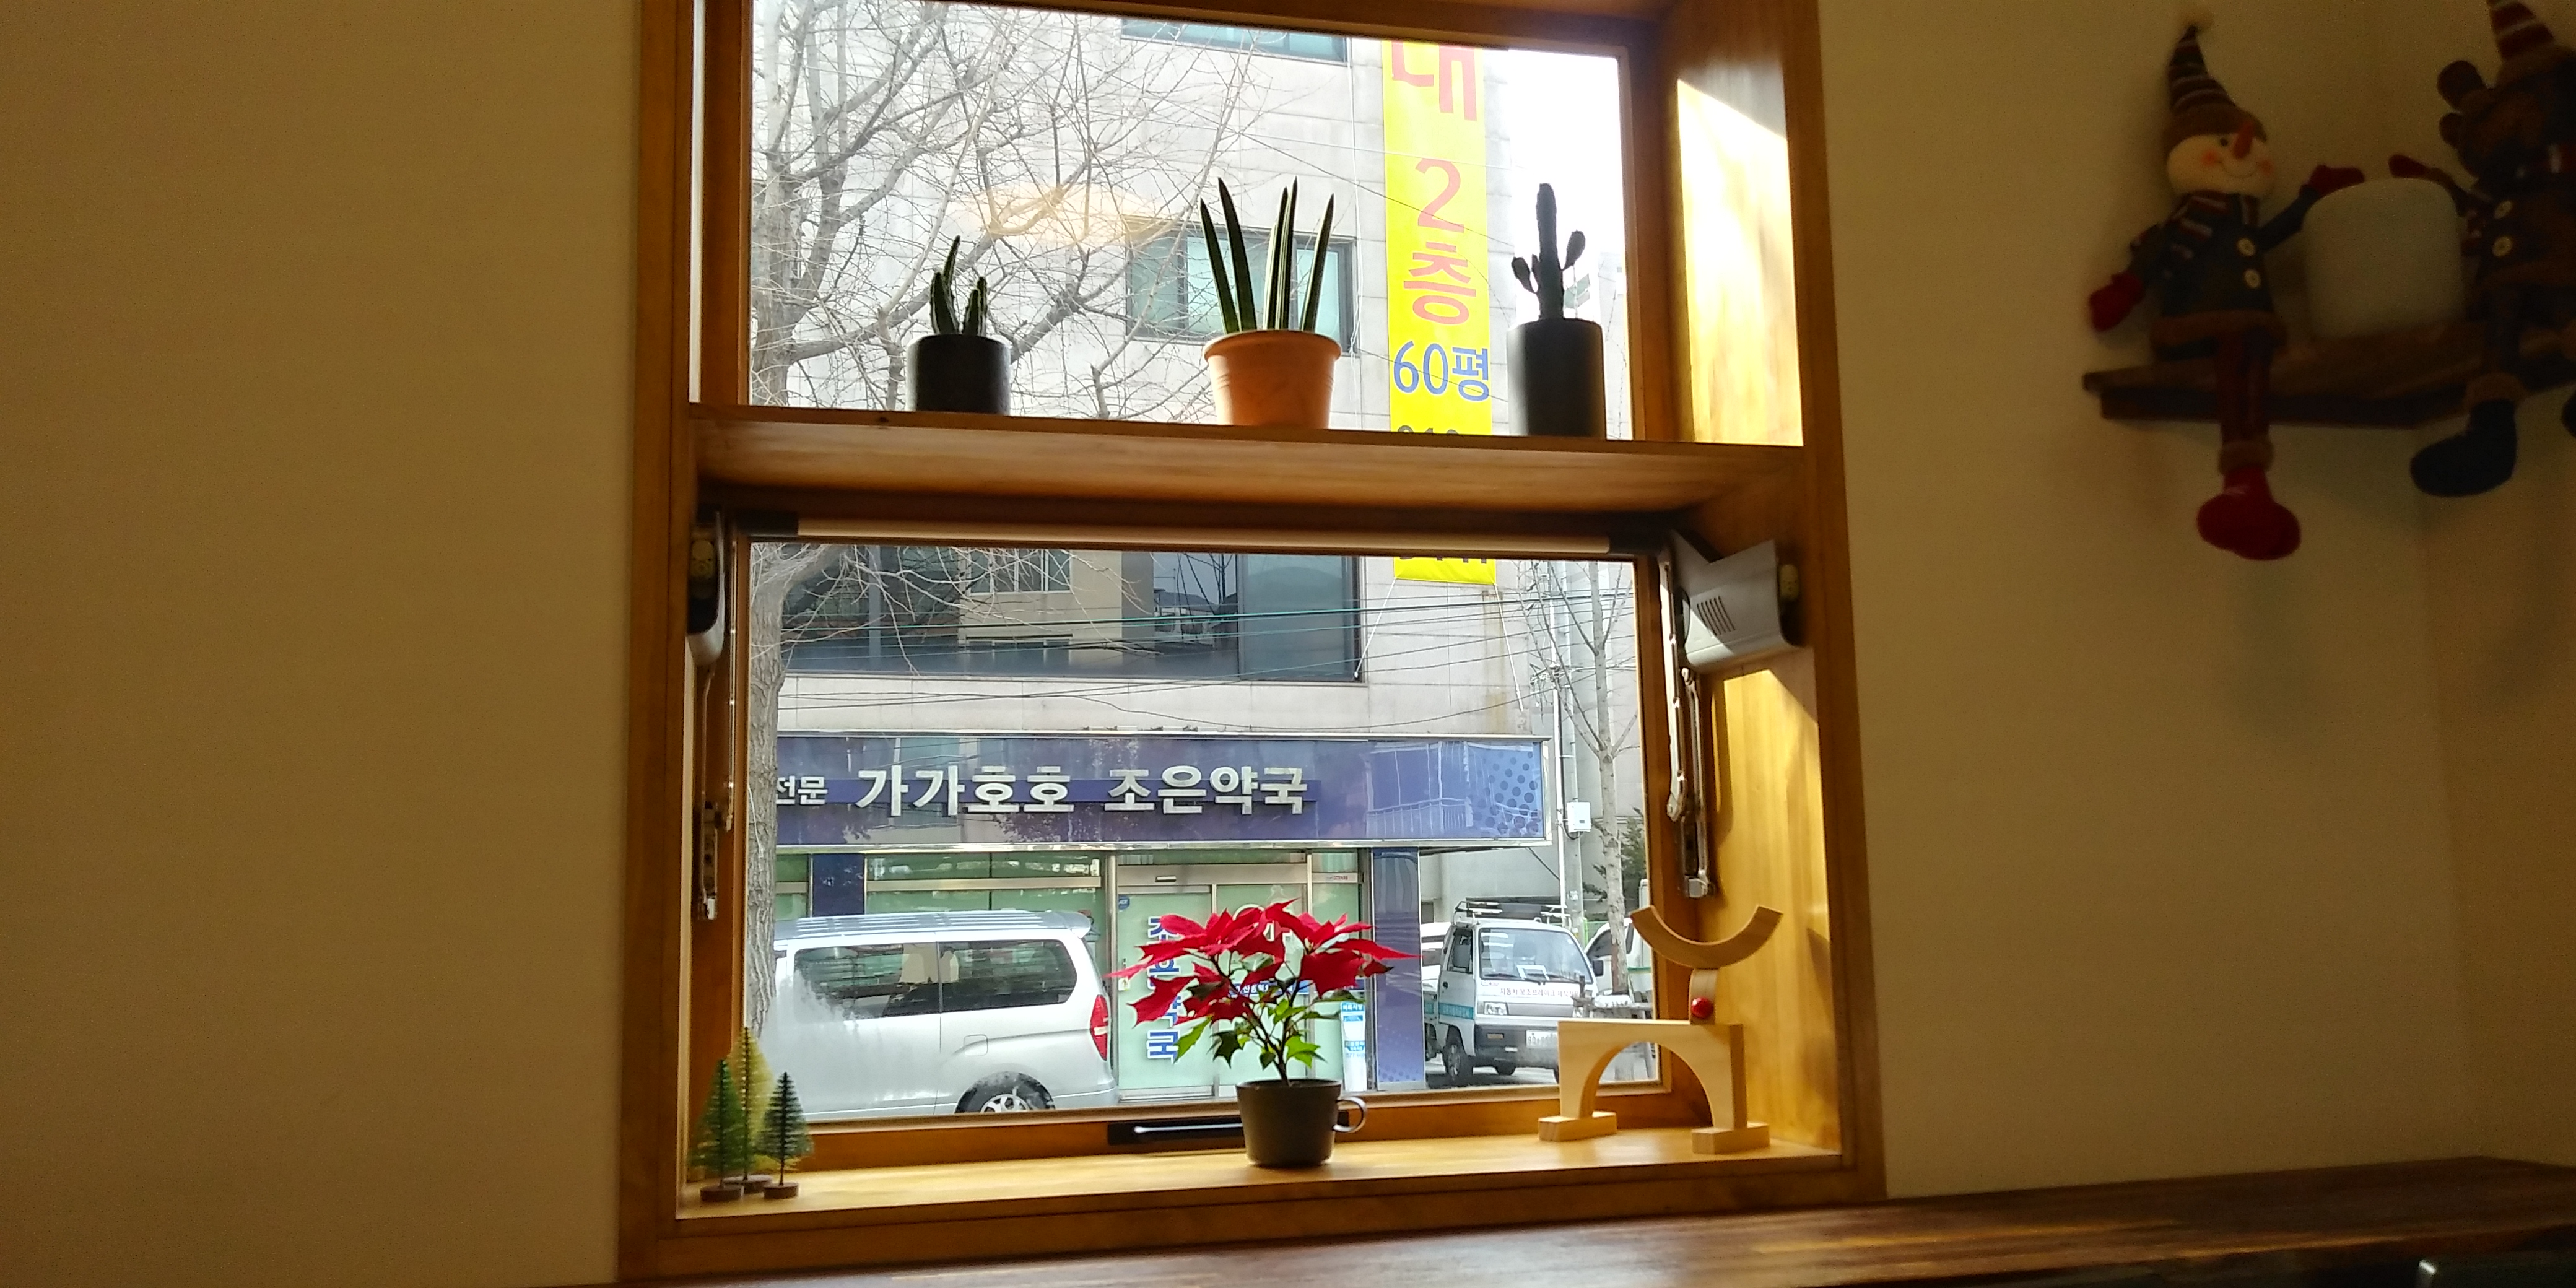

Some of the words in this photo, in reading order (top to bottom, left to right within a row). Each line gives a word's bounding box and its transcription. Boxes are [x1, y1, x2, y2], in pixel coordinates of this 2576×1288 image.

[1393, 341, 1490, 402] 60평
[775, 775, 829, 805] 전문
[856, 765, 1074, 816] 가가호호
[1104, 765, 1308, 815] 조은약국
